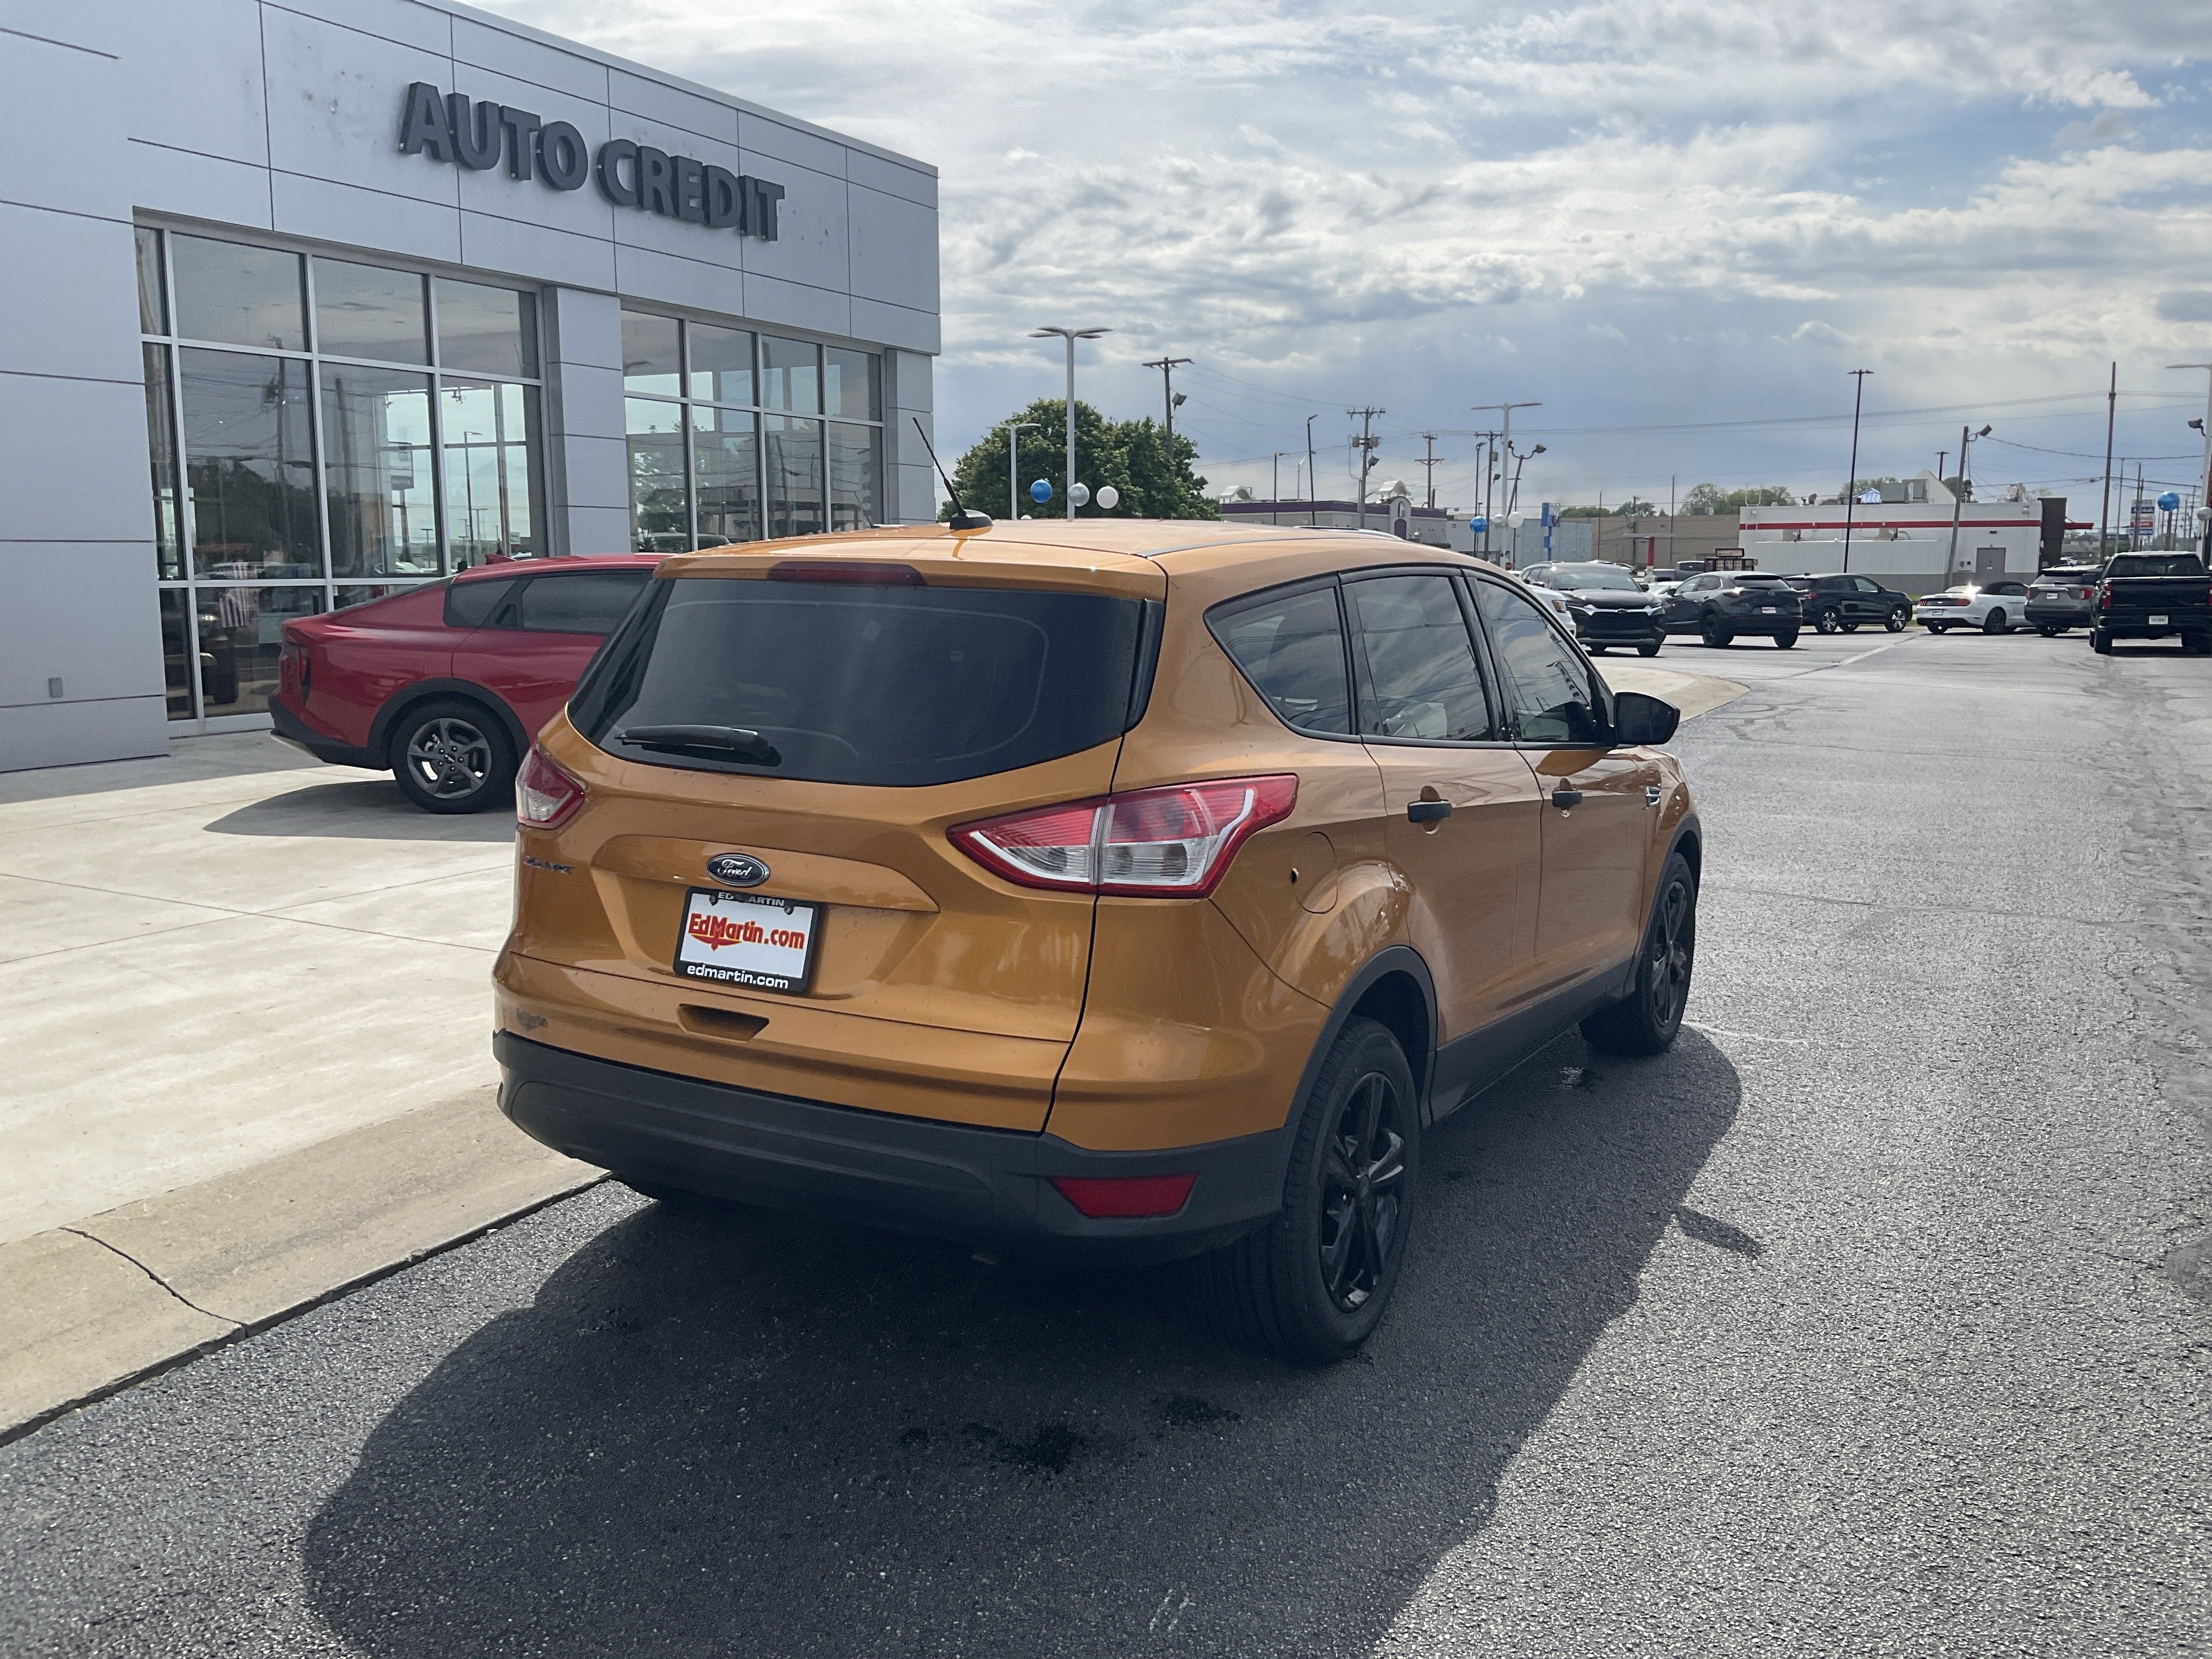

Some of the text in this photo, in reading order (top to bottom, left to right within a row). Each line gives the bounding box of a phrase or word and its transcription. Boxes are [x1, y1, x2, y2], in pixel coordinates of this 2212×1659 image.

[398, 81, 785, 242] AUTO CREDIT
[716, 859, 753, 878] Ford
[718, 891, 785, 907] ED ARTIN
[687, 912, 805, 950] EdMartin.com
[687, 963, 789, 989] edmartin.com
